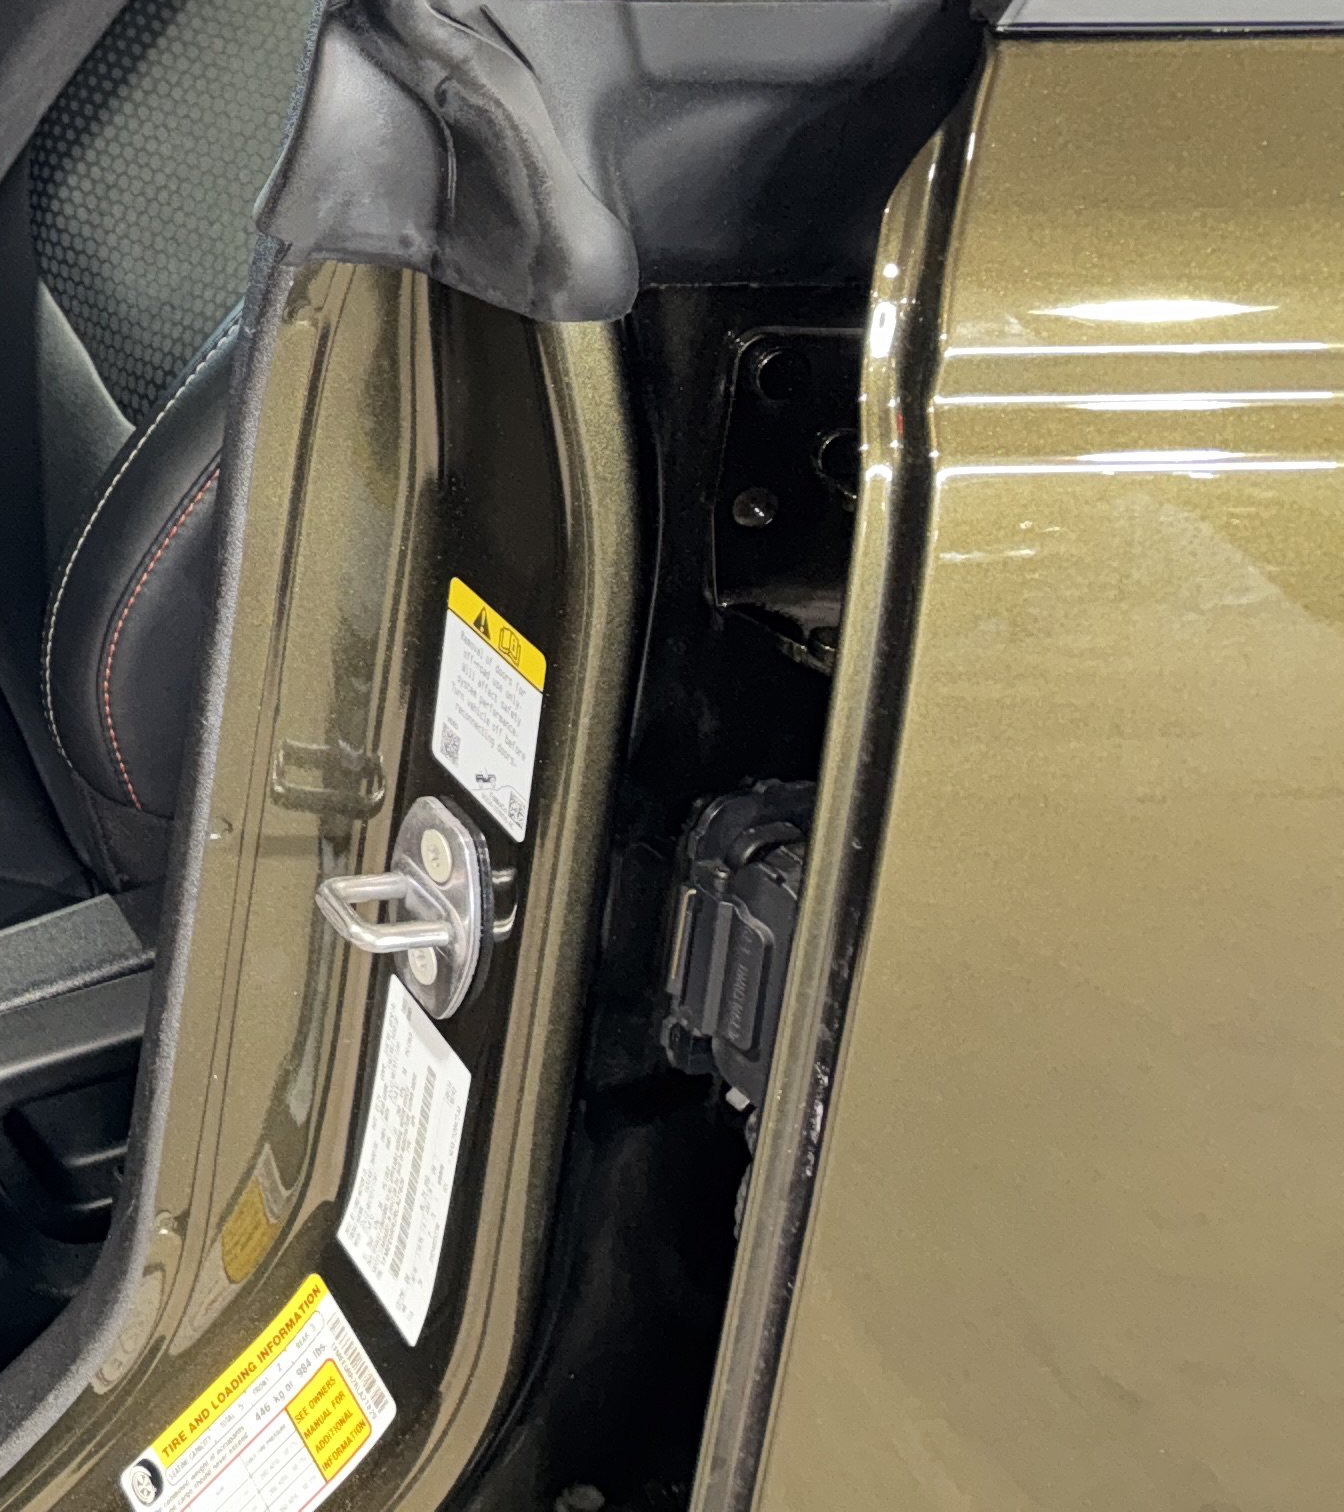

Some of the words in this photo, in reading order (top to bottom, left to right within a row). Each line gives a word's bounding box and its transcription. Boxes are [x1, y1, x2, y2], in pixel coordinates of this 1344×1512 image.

[161, 1431, 188, 1458] TIRE
[188, 1408, 210, 1433] AND
[210, 1361, 258, 1410] LOADING
[256, 1284, 322, 1363] INFORMATION
[255, 1401, 272, 1421] 446
[272, 1390, 285, 1404] kg
[285, 1381, 294, 1392] or
[295, 1358, 312, 1377] 984
[294, 1406, 310, 1424] SEE
[308, 1376, 337, 1410] OWNERS
[303, 1407, 332, 1439] MANUAL
[331, 1390, 346, 1410] FOR
[314, 1409, 354, 1454] ADDITIONAL
[322, 1420, 367, 1472] INFORMATION
